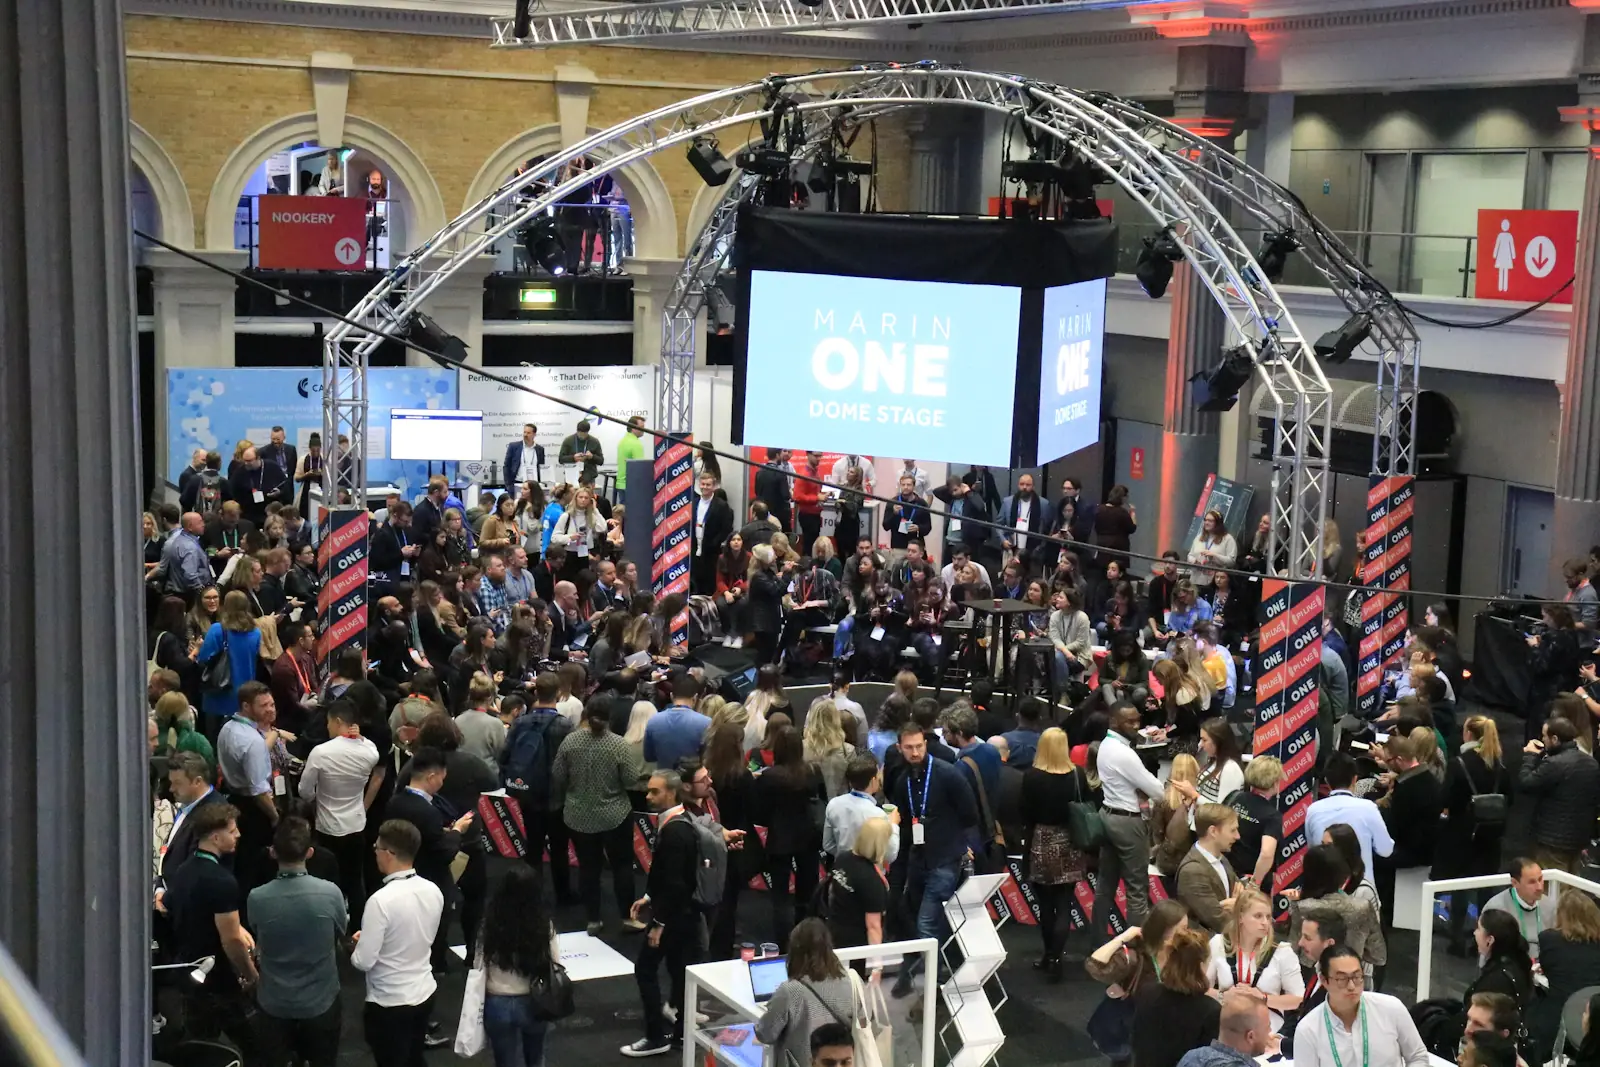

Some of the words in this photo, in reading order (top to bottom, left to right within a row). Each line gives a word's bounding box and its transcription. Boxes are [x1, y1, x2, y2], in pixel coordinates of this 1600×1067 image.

[272, 212, 335, 224] NOOKERY
[814, 308, 950, 340] MARIN
[1059, 312, 1092, 340] MARIN
[812, 336, 949, 397] ONE
[1057, 340, 1090, 396] ONE
[810, 400, 871, 422] DOME
[876, 404, 947, 427] STAGE
[1055, 405, 1071, 426] DOME
[1071, 400, 1088, 420] STAGE
[672, 461, 690, 476] ONE
[671, 496, 689, 511] ONE
[1394, 488, 1412, 505] ONE
[1371, 506, 1385, 521] ONE
[345, 525, 360, 538] LIVE
[670, 530, 688, 546] ONE
[1392, 526, 1409, 543] ONE
[338, 548, 364, 570] ONE
[1369, 545, 1383, 559] ONE
[345, 571, 360, 585] LIVE
[669, 564, 687, 580] ONE
[1390, 564, 1407, 580] ONE
[338, 594, 363, 616] ONE
[1266, 598, 1286, 618] ONE
[1296, 610, 1304, 622] PI
[1304, 601, 1318, 618] LIVE
[1388, 601, 1404, 619] ONE
[345, 618, 359, 631] LIVE
[1365, 620, 1379, 634] ONE
[672, 632, 685, 646] NE
[1294, 626, 1319, 650] ONE
[1385, 639, 1402, 656] ONE
[1264, 650, 1283, 670] ONE
[1293, 663, 1301, 673] PI
[1301, 653, 1314, 670] LIVE
[1363, 658, 1378, 672] ONE
[1291, 678, 1316, 702] ONE
[1261, 702, 1280, 722] ONE
[1290, 715, 1298, 725] PI
[1297, 705, 1310, 722] LIVE
[1288, 730, 1312, 754] ONE
[1286, 766, 1294, 777] PI
[1294, 755, 1308, 773] LIVE
[1285, 781, 1309, 806] ONE
[639, 818, 651, 835] ONE
[1284, 818, 1291, 829] PI
[1291, 807, 1304, 825] LIVE
[494, 801, 506, 818] ONE
[504, 820, 516, 837] ONE
[514, 839, 526, 856] ONE
[481, 835, 493, 852] ONE
[1282, 833, 1306, 858] ONE
[1281, 869, 1288, 880] PI
[1288, 859, 1302, 877] LIVE
[1088, 872, 1097, 889] ON
[1010, 863, 1022, 881] ONE
[1021, 883, 1034, 902] ONE
[1032, 904, 1040, 921] ON
[994, 899, 1008, 918] ONE
[1071, 909, 1084, 928] ONE
[1110, 914, 1123, 933] ONE
